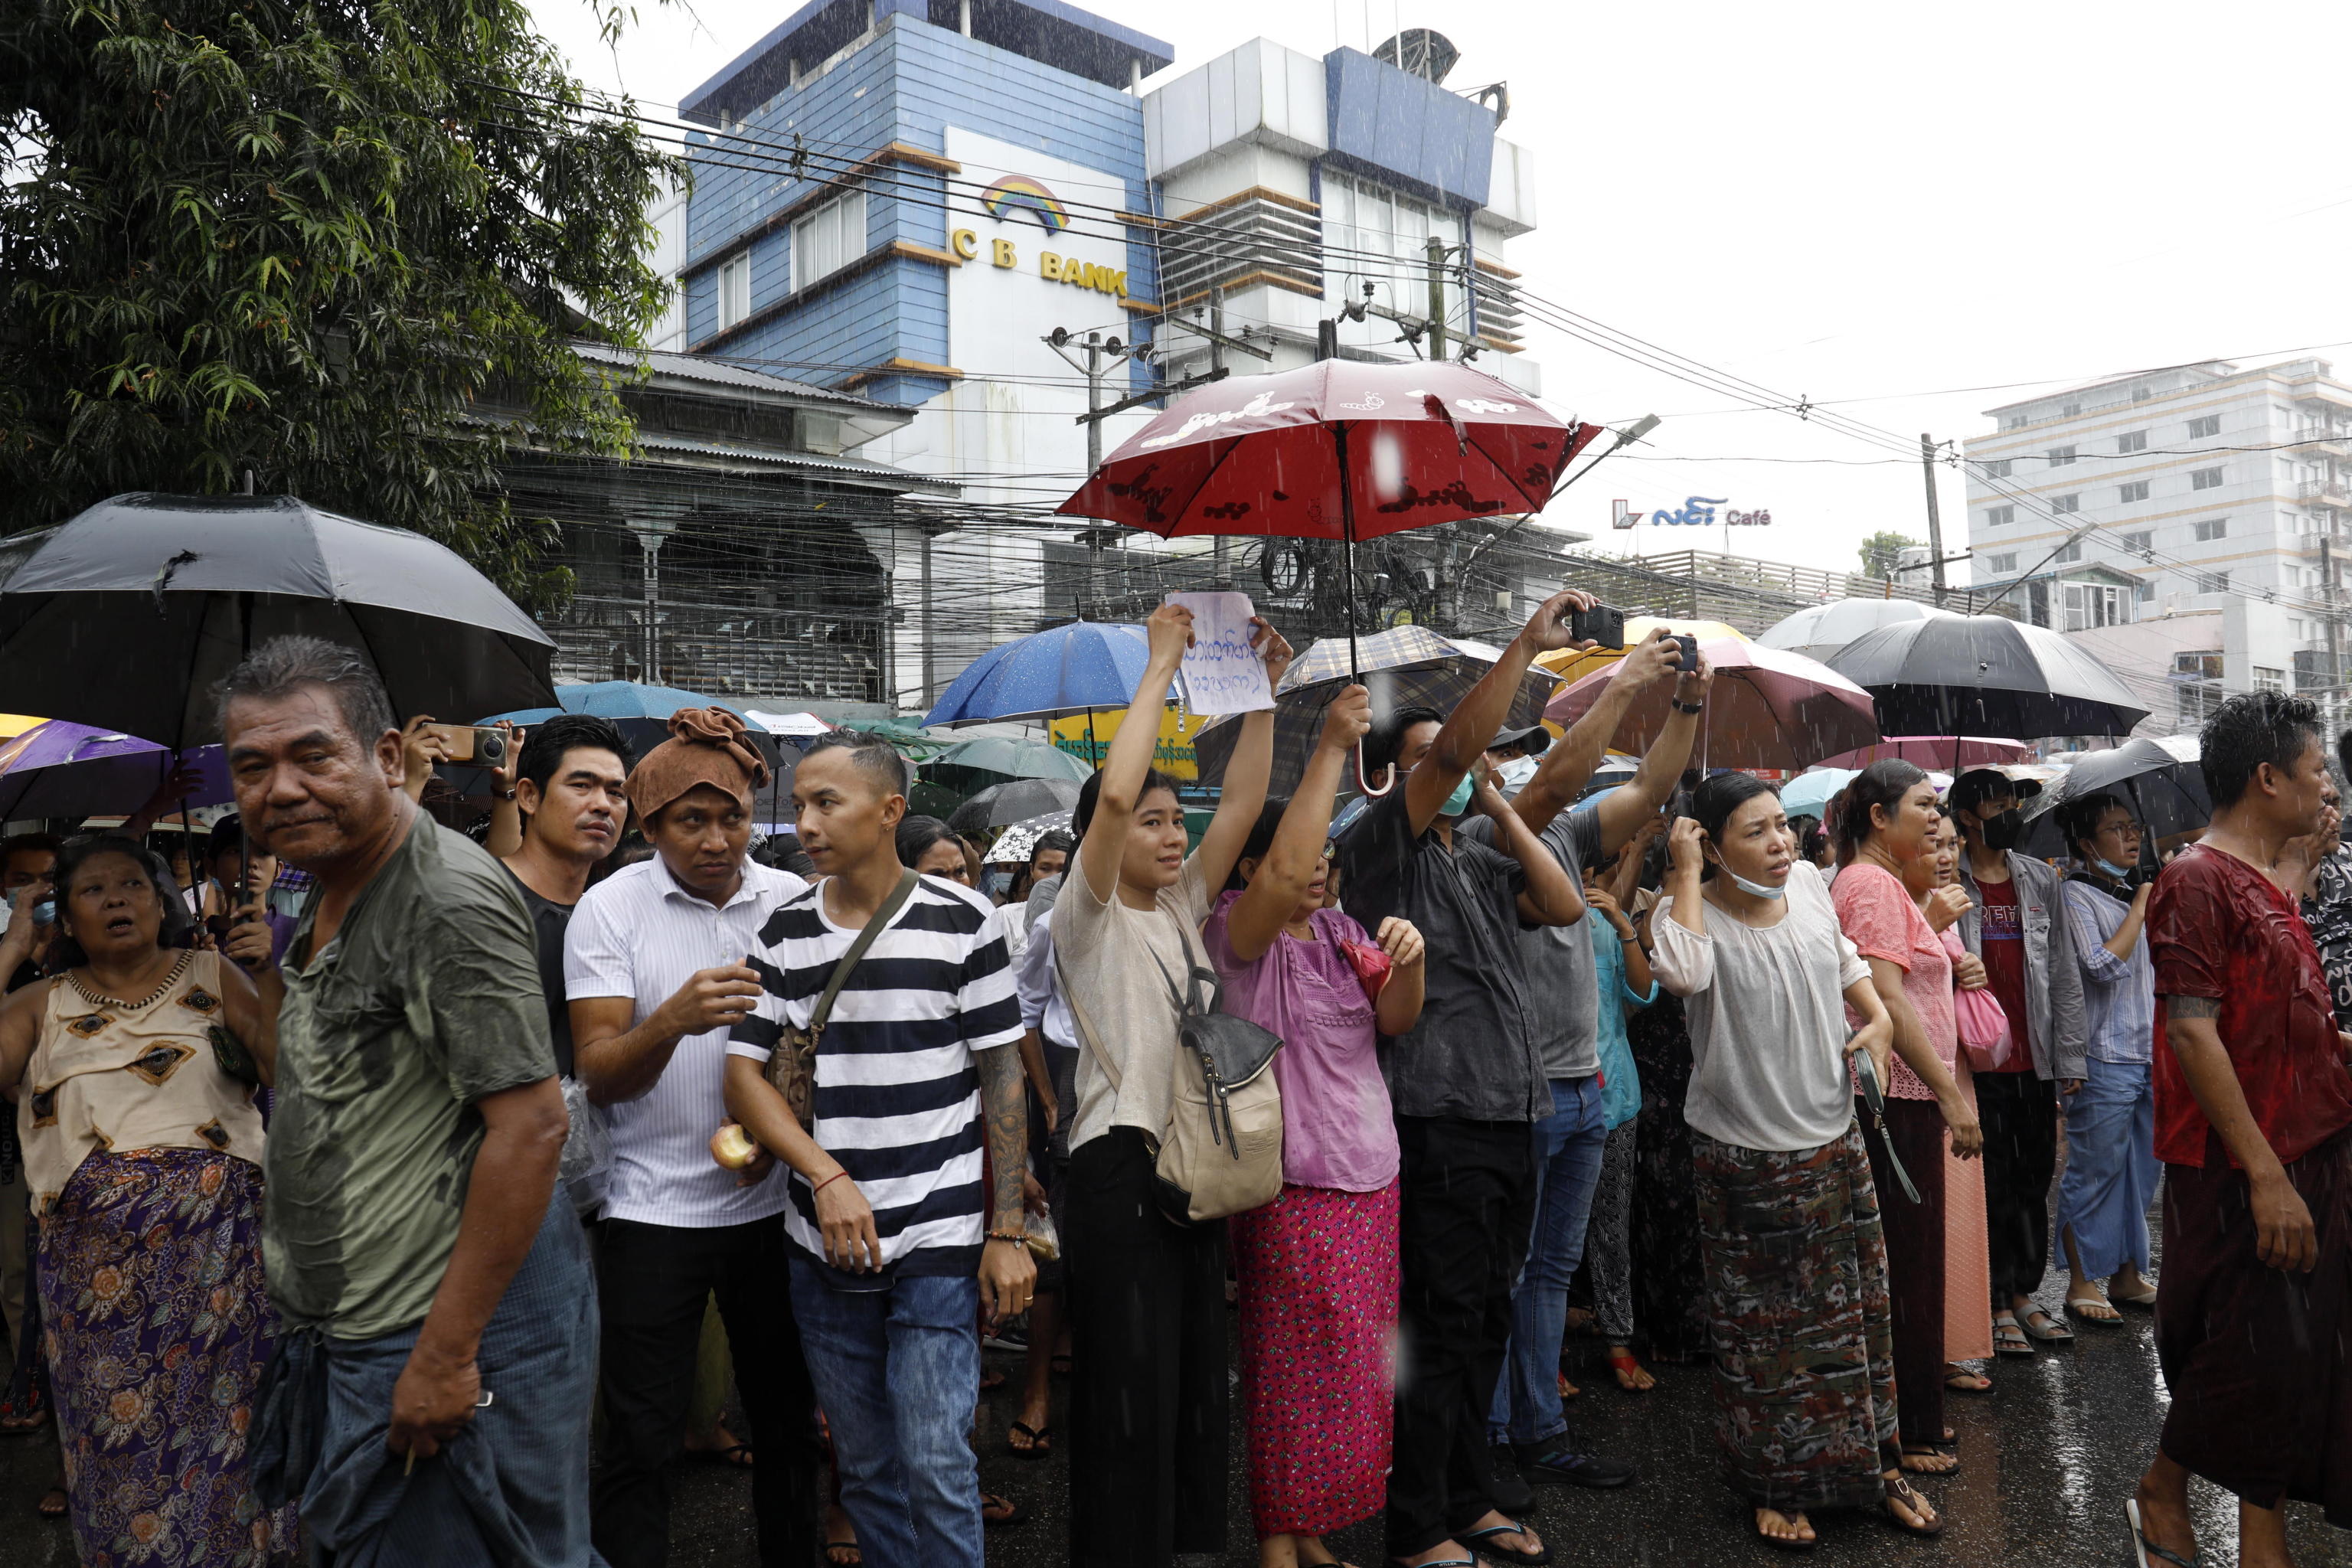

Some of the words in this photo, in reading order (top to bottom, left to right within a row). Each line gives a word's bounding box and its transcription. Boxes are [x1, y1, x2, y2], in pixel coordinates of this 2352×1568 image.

[953, 229, 978, 261] C
[992, 238, 1018, 269] B
[1040, 250, 1128, 298] BANK
[1726, 508, 1772, 527] Café
